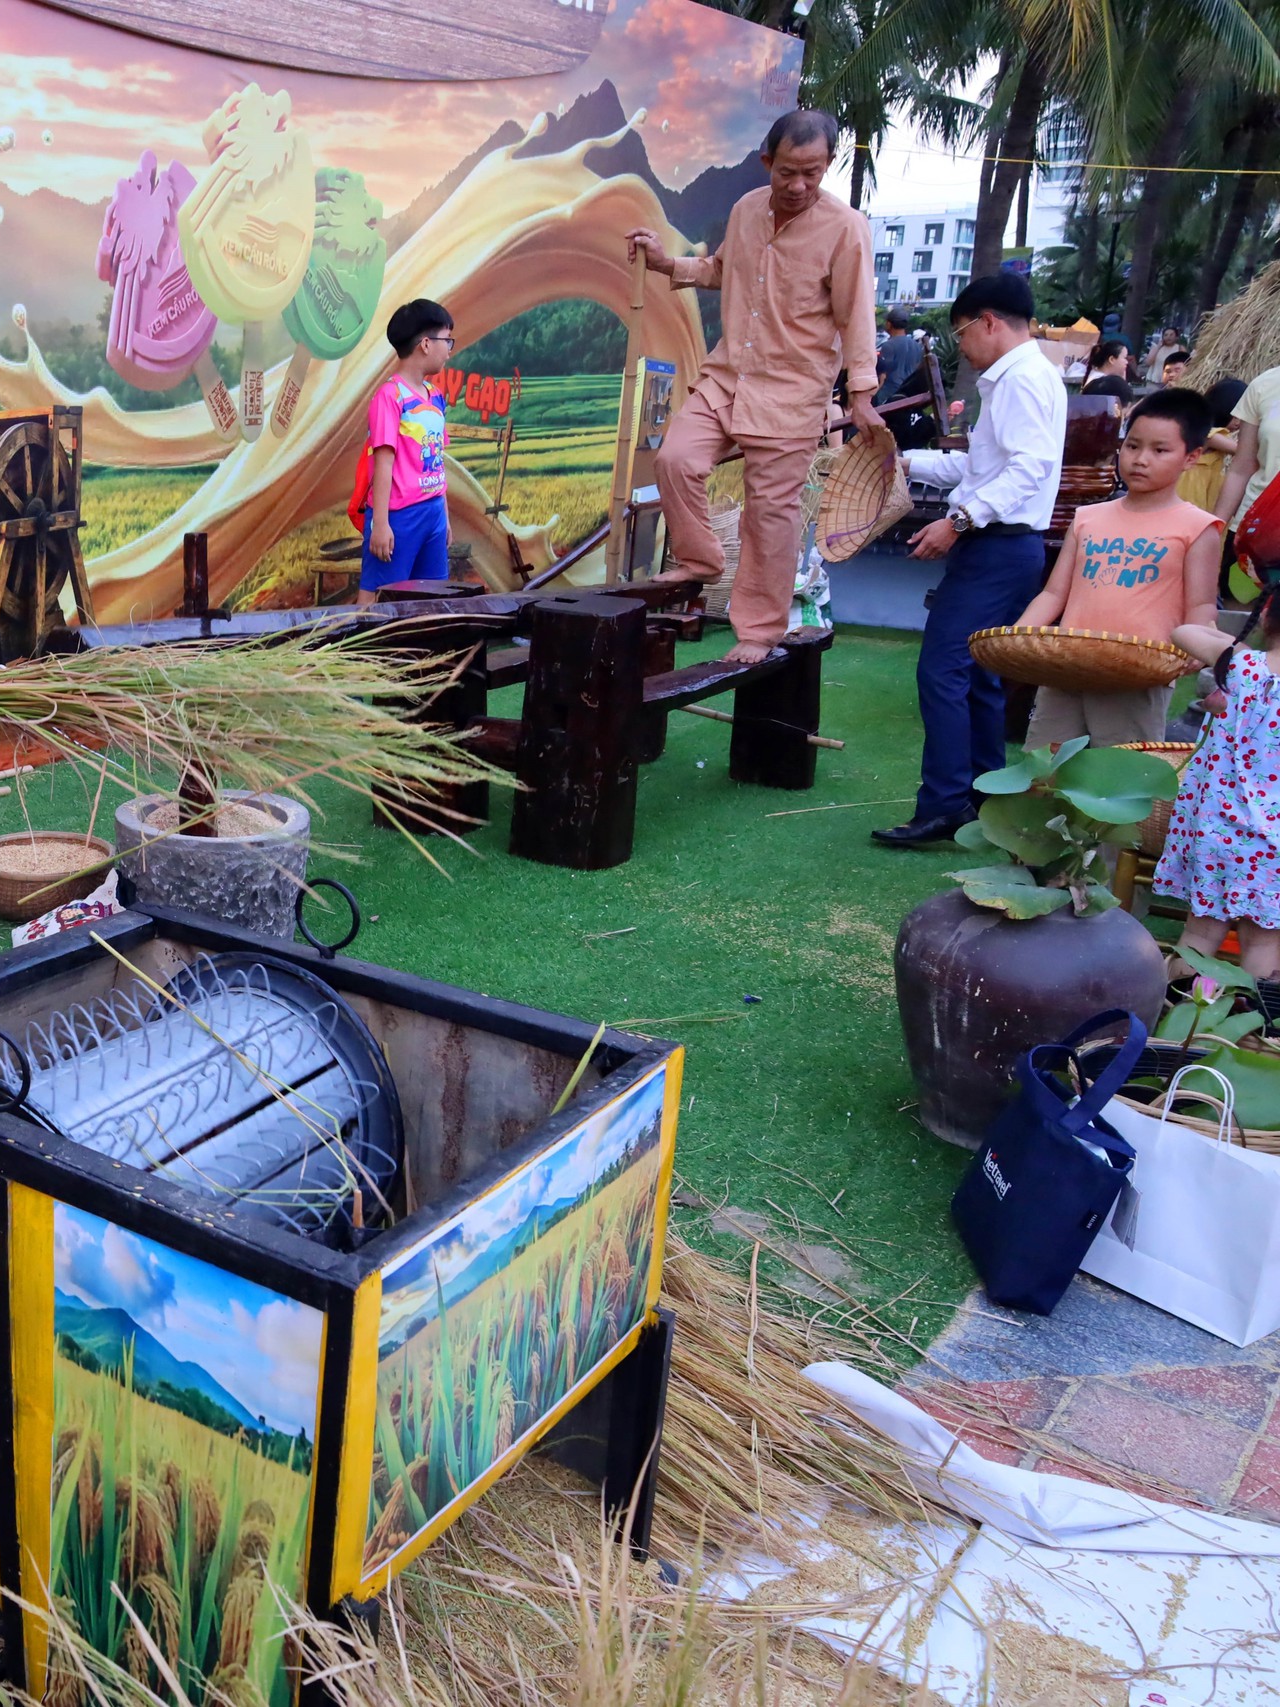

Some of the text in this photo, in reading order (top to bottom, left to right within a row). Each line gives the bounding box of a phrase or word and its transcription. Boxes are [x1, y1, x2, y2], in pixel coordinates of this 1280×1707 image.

[249, 371, 257, 416] Flavors
[255, 371, 264, 416] Natural
[424, 367, 514, 424] AY GẠO
[1085, 537, 1169, 564] WASH
